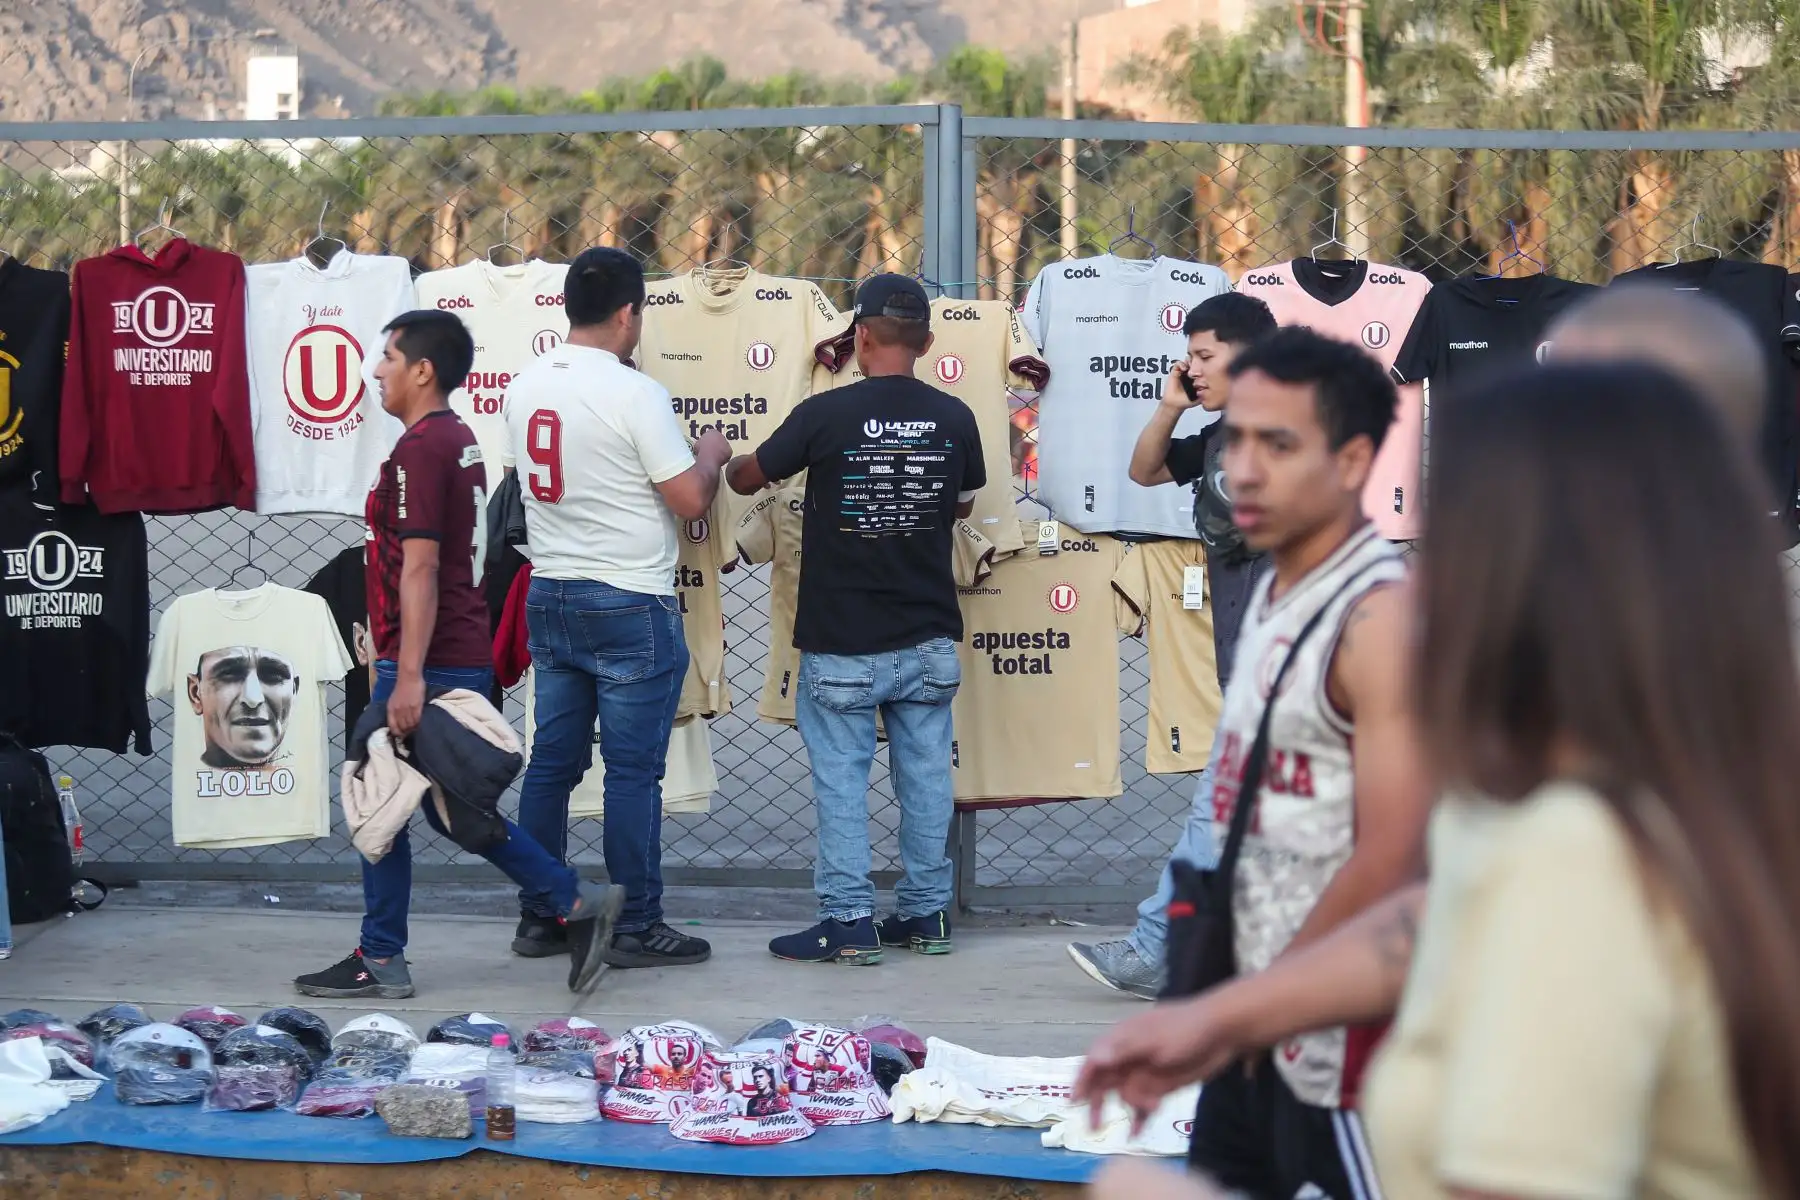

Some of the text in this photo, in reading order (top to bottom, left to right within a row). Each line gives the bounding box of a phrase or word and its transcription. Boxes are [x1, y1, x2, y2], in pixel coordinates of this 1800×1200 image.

[115, 300, 214, 338] 19 U 24
[1075, 315, 1119, 323] marathon
[1166, 310, 1183, 329] U
[1369, 326, 1384, 345] U
[1449, 341, 1488, 350] marathon
[114, 348, 213, 373] UNIVERSITARIO
[661, 352, 702, 362] marathon
[752, 347, 769, 368] U
[131, 373, 191, 386] DE DEPORTES
[299, 344, 347, 411] U
[940, 359, 959, 380] U
[1109, 377, 1163, 401] total
[672, 393, 768, 420] apuesta
[286, 411, 364, 441] DESDE 1924
[885, 421, 937, 431] ULTRA
[527, 408, 565, 504] 9
[740, 495, 776, 528] JETOUR
[6, 543, 104, 581] 19 U 24
[958, 587, 1002, 596] marathon
[1054, 589, 1072, 609] U
[5, 592, 103, 617] UNVERSITARIO
[21, 616, 81, 629] DE DEPORTES
[972, 628, 1071, 654] apuesta
[992, 653, 1053, 675] total
[197, 768, 295, 797] LOLO
